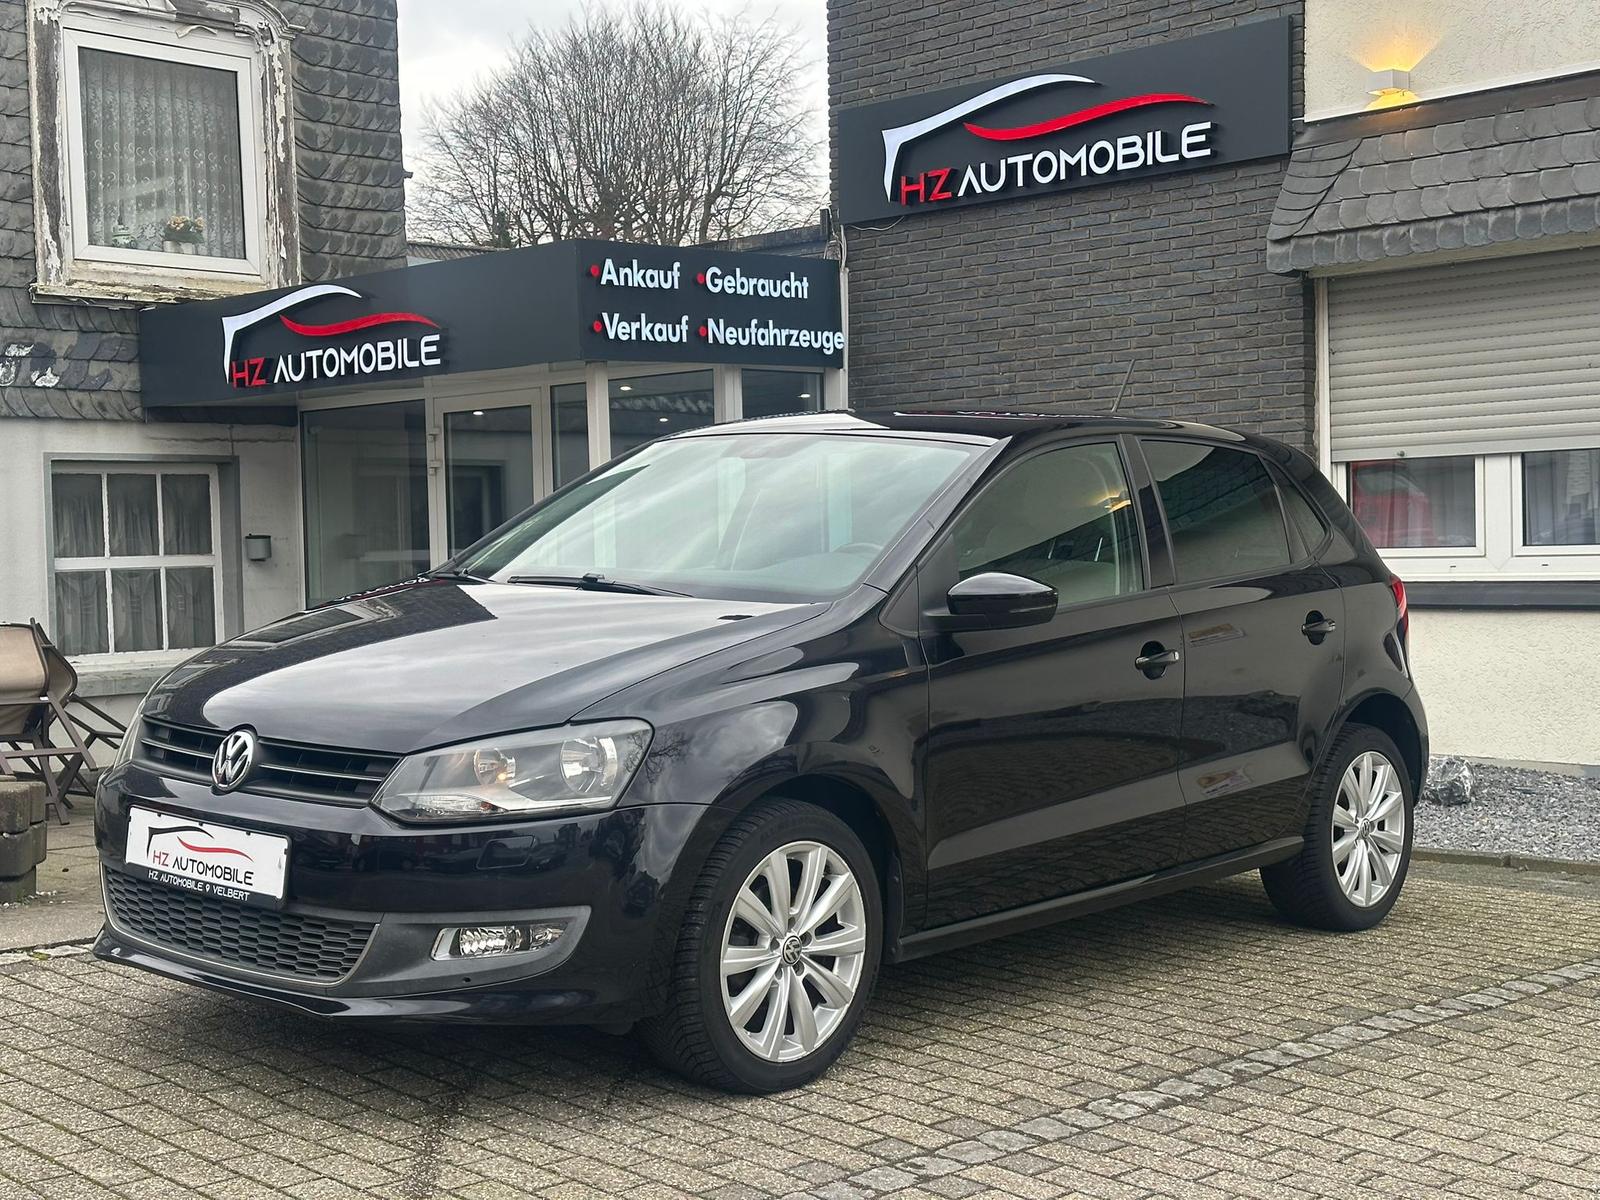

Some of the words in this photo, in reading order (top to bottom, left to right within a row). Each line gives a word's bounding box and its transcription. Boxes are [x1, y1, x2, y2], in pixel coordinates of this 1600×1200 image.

[901, 167, 953, 205] HZ
[957, 121, 1211, 196] AUTOMOBILE
[600, 258, 680, 289] Ankauf
[705, 266, 809, 299] Gebraucht
[601, 312, 689, 343] Verkauf
[707, 317, 845, 355] Neufahrzeuge
[231, 357, 267, 388] HZ
[274, 334, 440, 383] AUTOMOBILE
[152, 850, 170, 867] HZ
[173, 856, 254, 886] AUTOMOBILE
[148, 870, 158, 881] HZ
[160, 874, 203, 891] AUTOMOBILE
[213, 885, 249, 901] VELBERT
